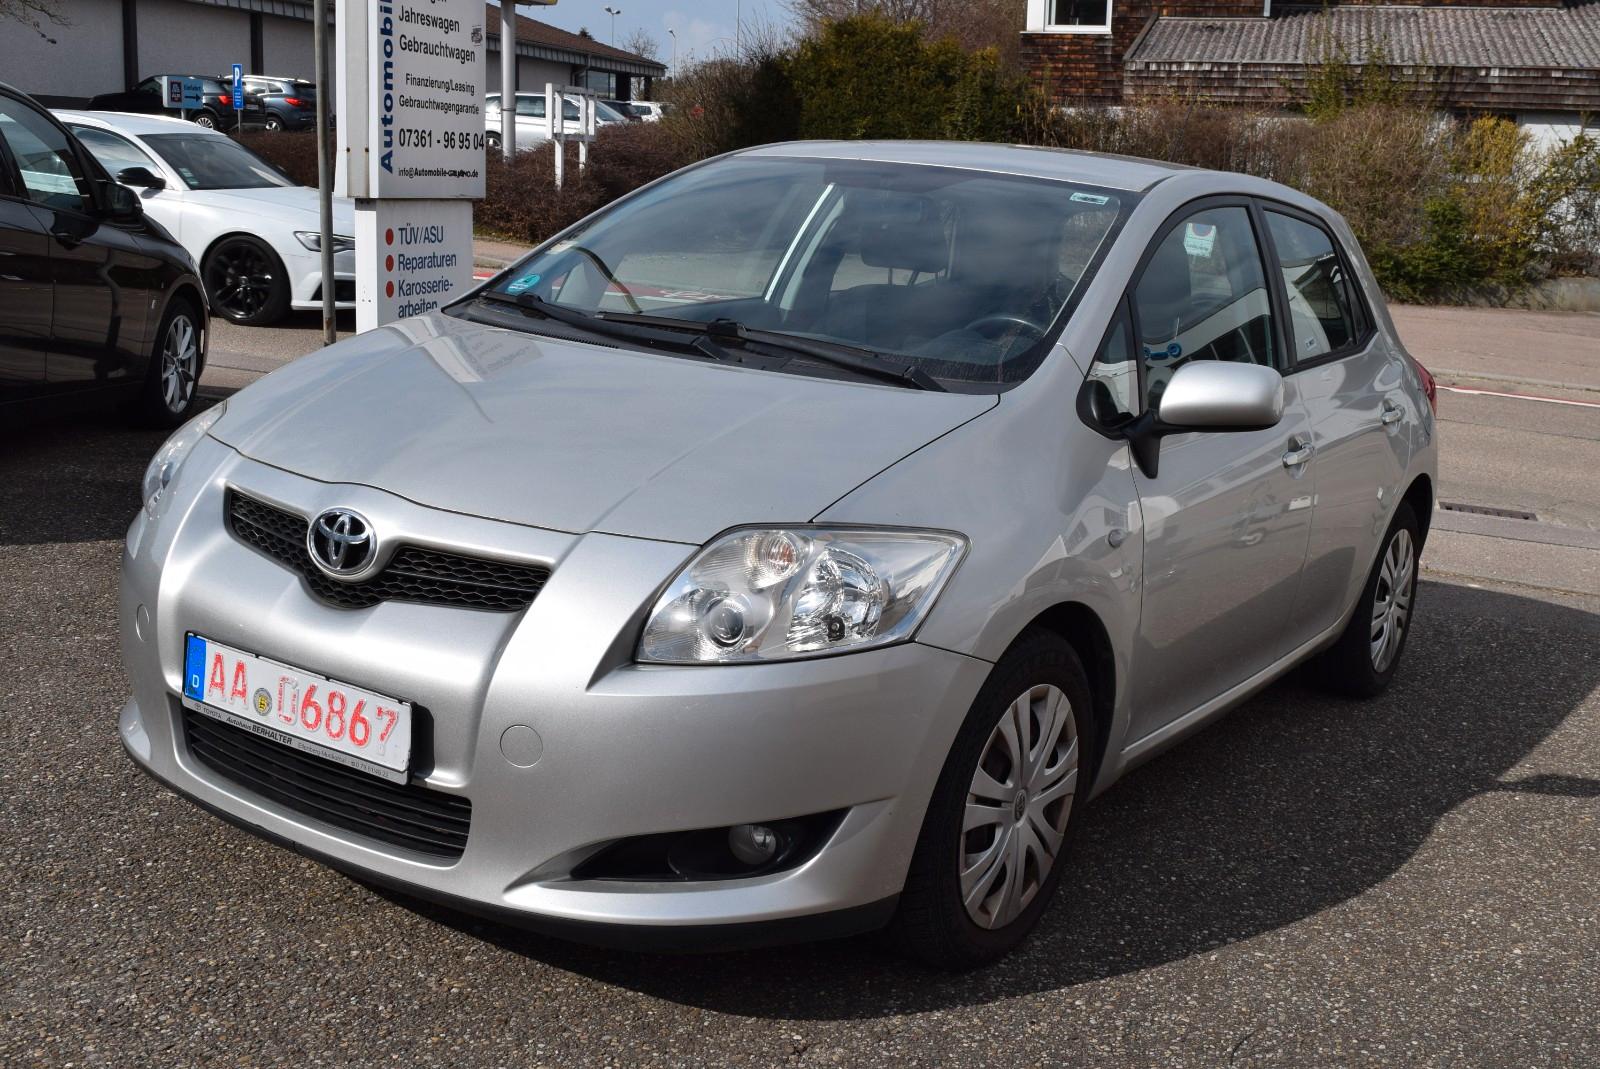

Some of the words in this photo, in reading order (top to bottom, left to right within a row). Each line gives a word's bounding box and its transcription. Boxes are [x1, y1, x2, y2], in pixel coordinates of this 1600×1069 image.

[399, 5, 460, 34] Jahreswagen
[400, 34, 475, 64] Gebrauchtwagen
[234, 66, 240, 87] P
[380, 0, 393, 174] Automobi
[399, 95, 479, 115] Gebrauchtwagengarantie
[399, 128, 432, 148] 07361
[443, 131, 456, 149] 96
[459, 132, 471, 150] 95
[473, 133, 485, 150] 04
[398, 222, 444, 245] TÜV/ASU
[398, 252, 457, 274] Reparaturen
[398, 276, 454, 297] Karosserie-
[192, 674, 200, 688] D
[208, 651, 248, 710] AA
[226, 716, 252, 731] Autohaus
[252, 725, 293, 745] BERHALTER
